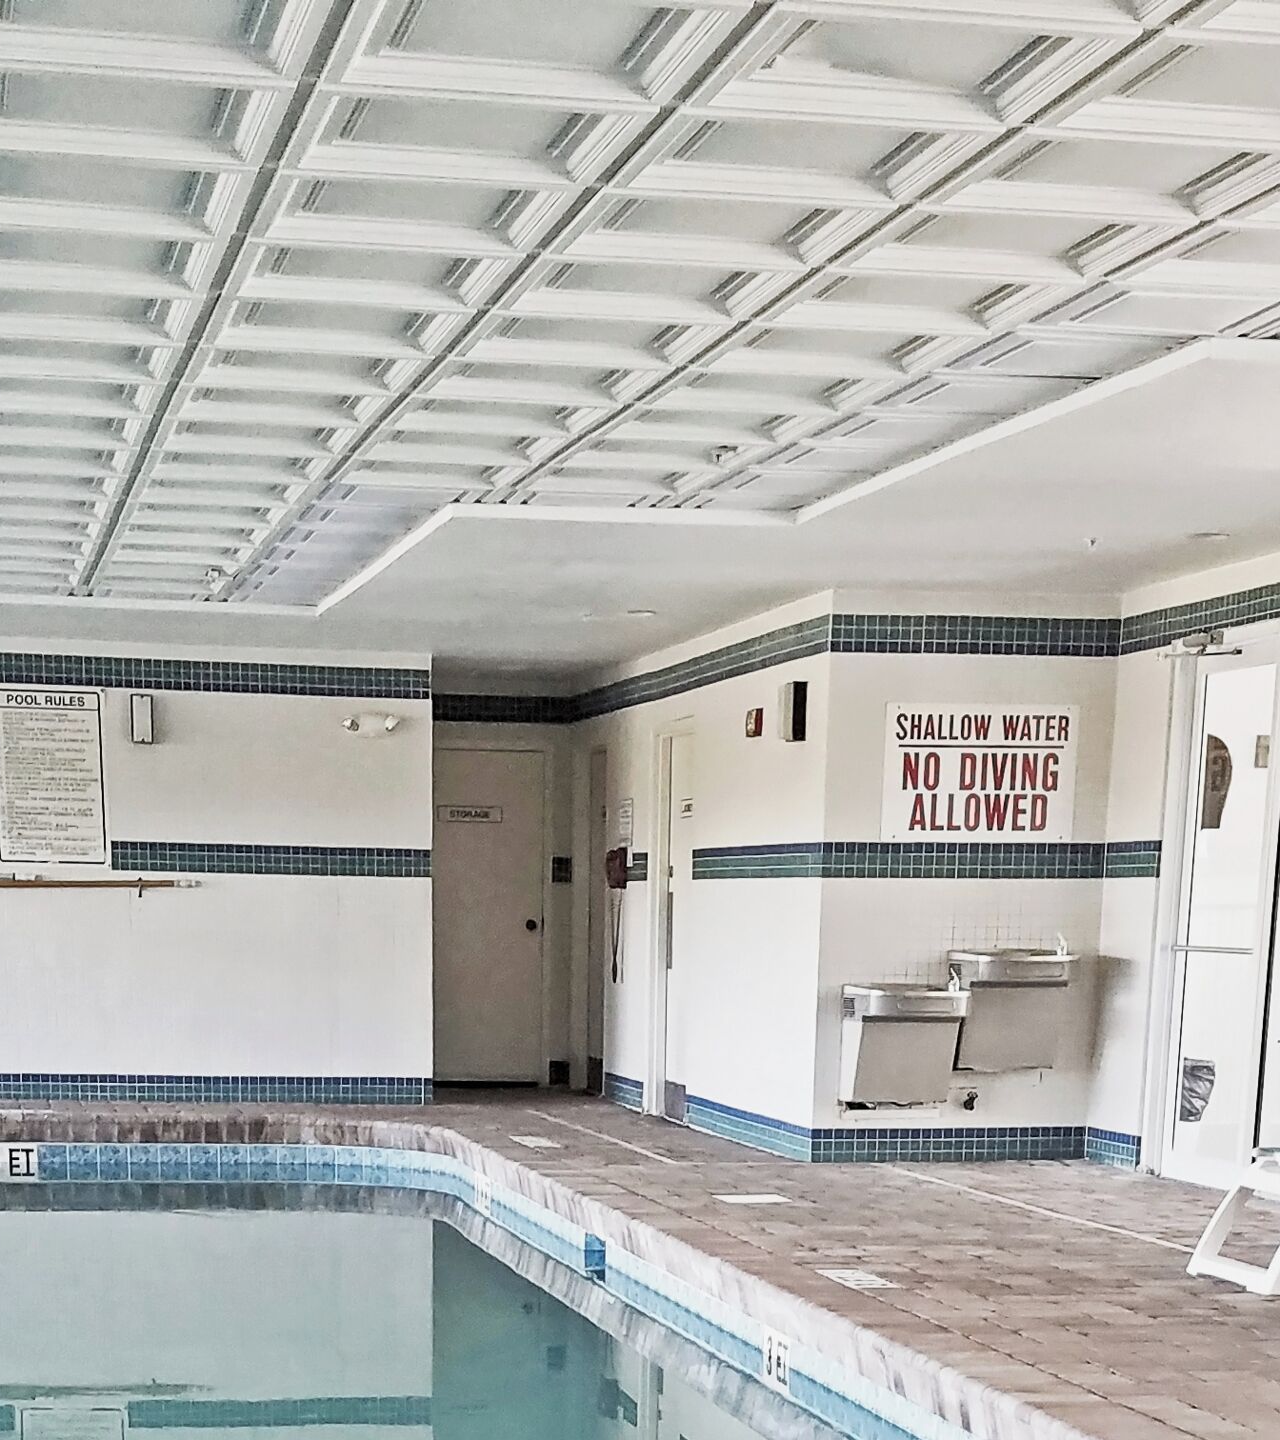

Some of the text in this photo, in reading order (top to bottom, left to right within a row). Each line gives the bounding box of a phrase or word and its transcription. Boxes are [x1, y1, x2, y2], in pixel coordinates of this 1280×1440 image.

[7, 694, 85, 707] POOL RULES
[896, 713, 1070, 741] SHALLOW WATER
[902, 752, 1059, 791] NO DIVING
[908, 793, 1048, 831] ALLOWED
